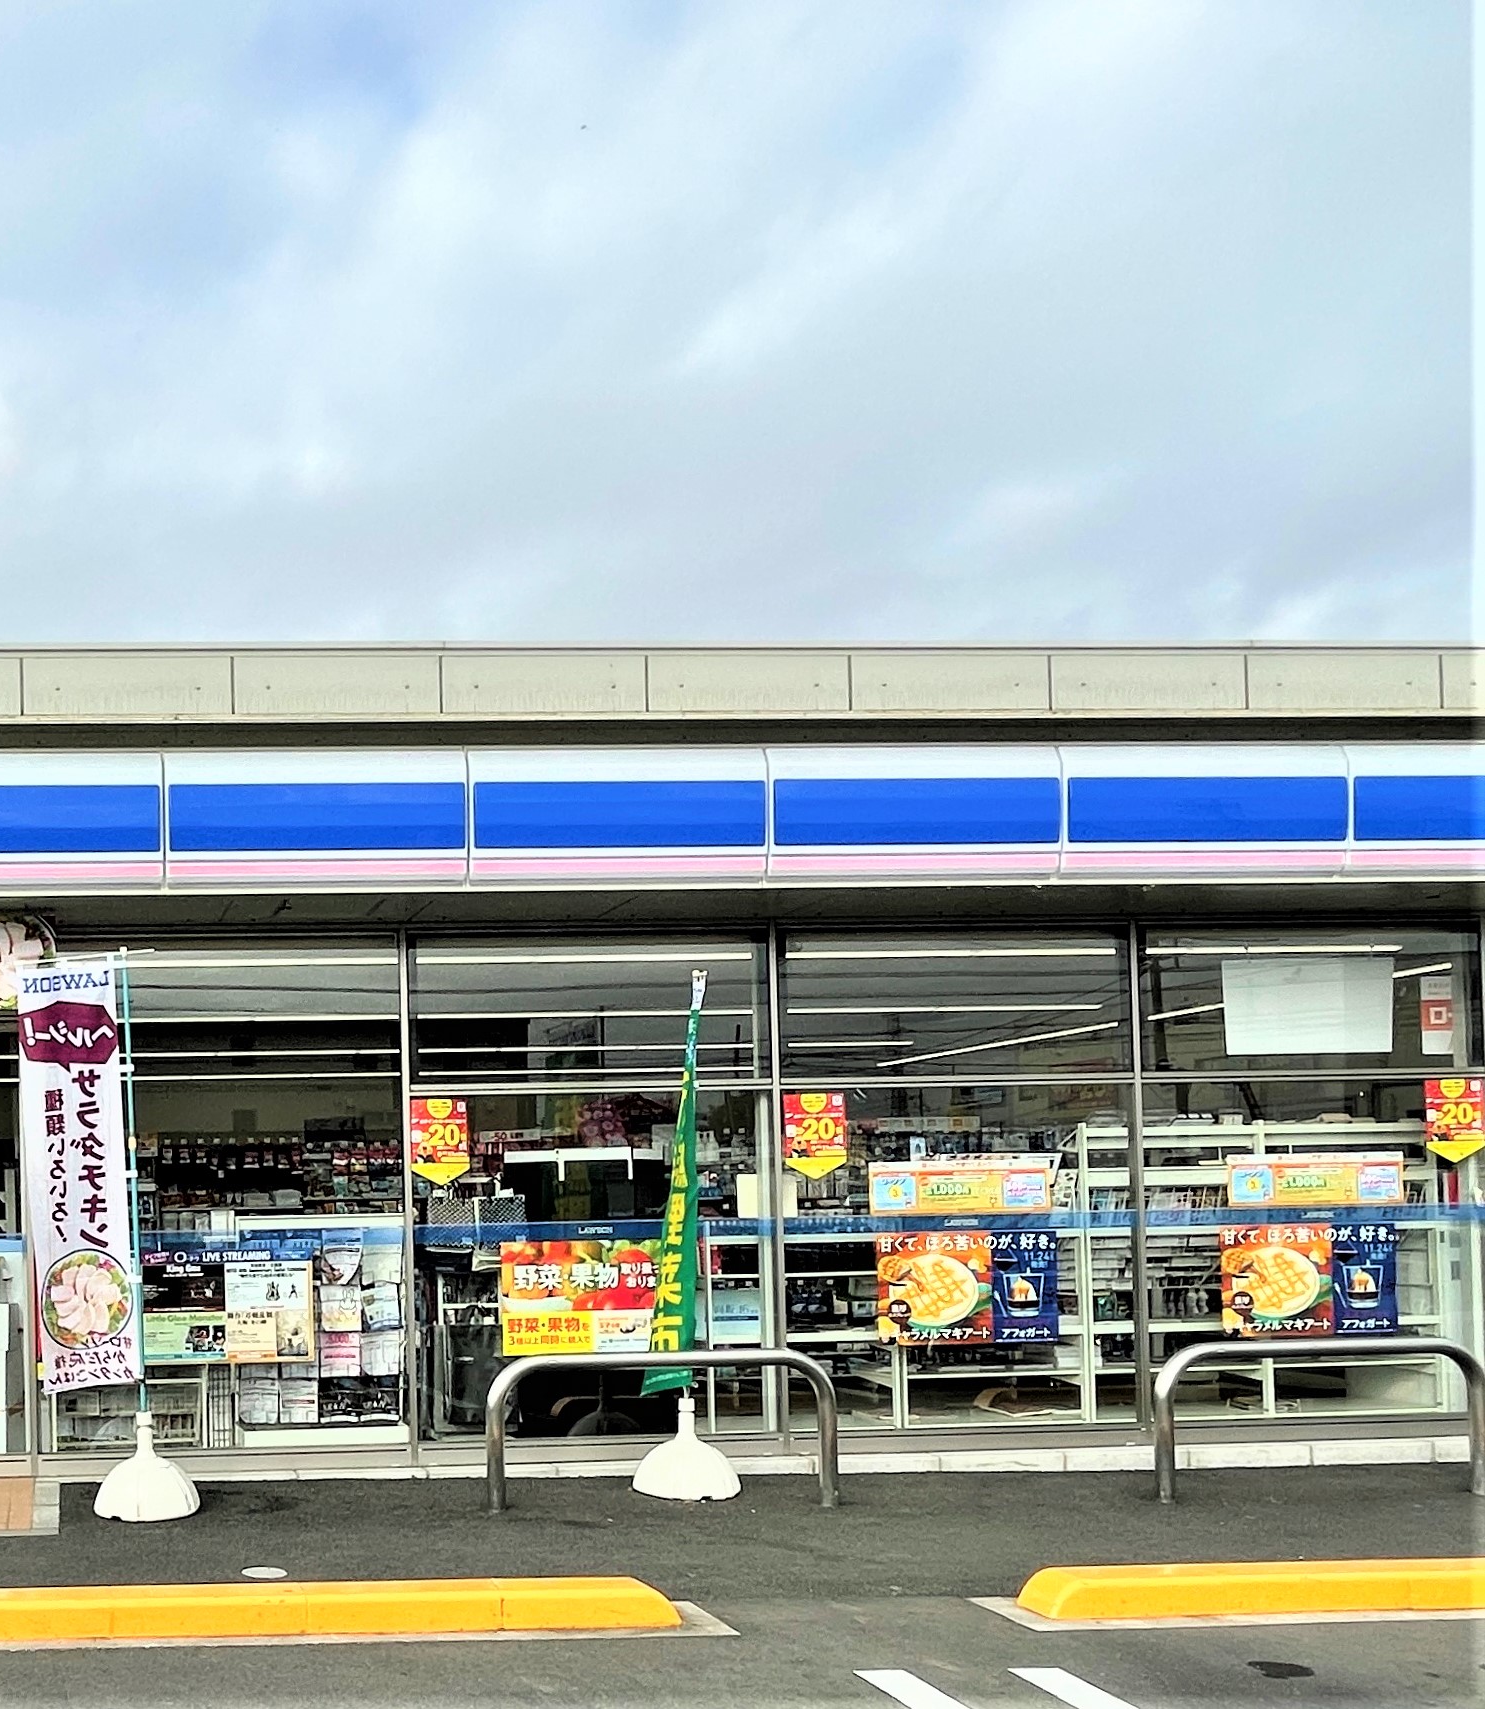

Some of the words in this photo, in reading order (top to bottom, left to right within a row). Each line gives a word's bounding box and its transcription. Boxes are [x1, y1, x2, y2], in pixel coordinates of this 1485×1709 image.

[877, 1232, 1057, 1252] 甘くて、ほろ苦いのが、好き。
[1222, 1225, 1396, 1245] 甘くて、ほろ苦いのが、好き。
[202, 1251, 221, 1262] LIVE
[222, 1250, 271, 1261] STREAMING
[513, 1262, 619, 1290] 野菜・果物
[1001, 1326, 1051, 1339] アフォガート
